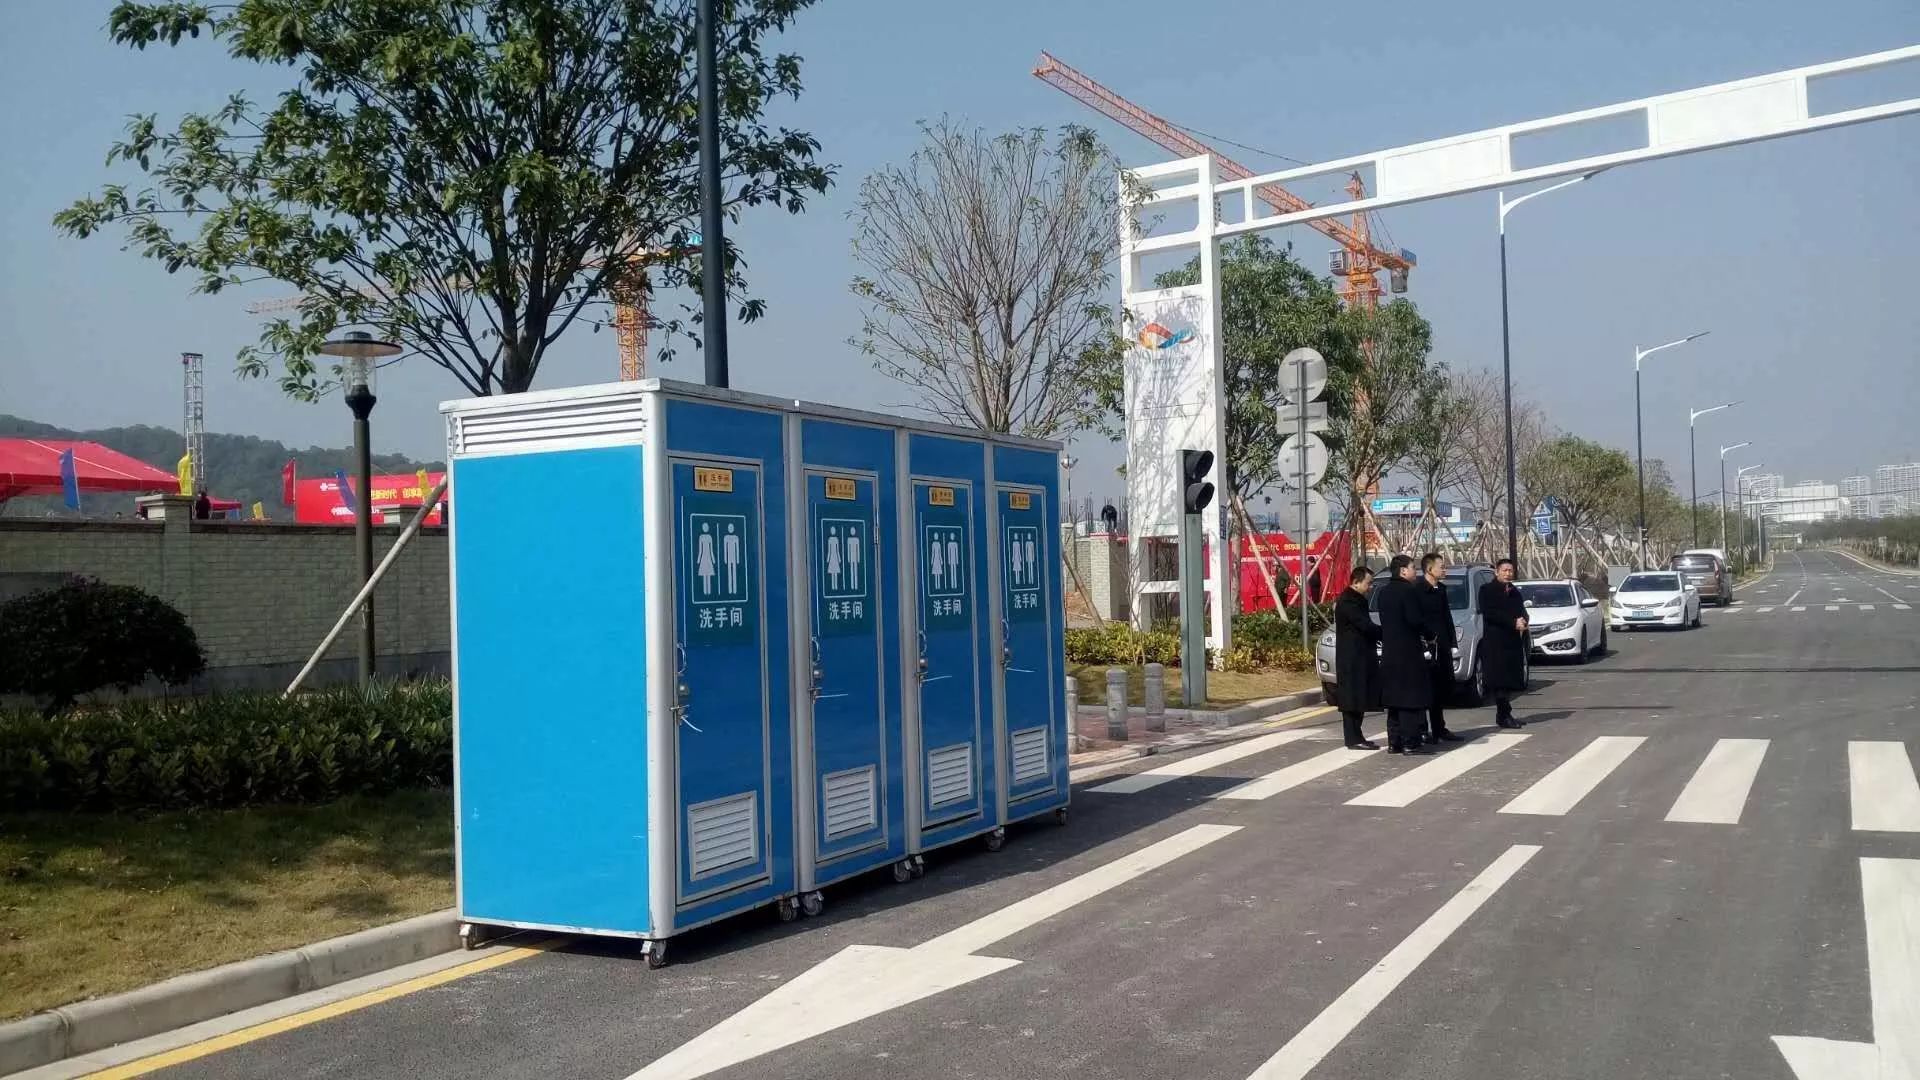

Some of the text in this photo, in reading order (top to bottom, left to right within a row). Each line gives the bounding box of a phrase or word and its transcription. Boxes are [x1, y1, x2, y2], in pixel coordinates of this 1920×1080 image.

[829, 600, 863, 620] 洗手间
[933, 598, 962, 616] 洗手间
[1014, 593, 1038, 609] 洗手间
[699, 607, 743, 628] 洗手间
